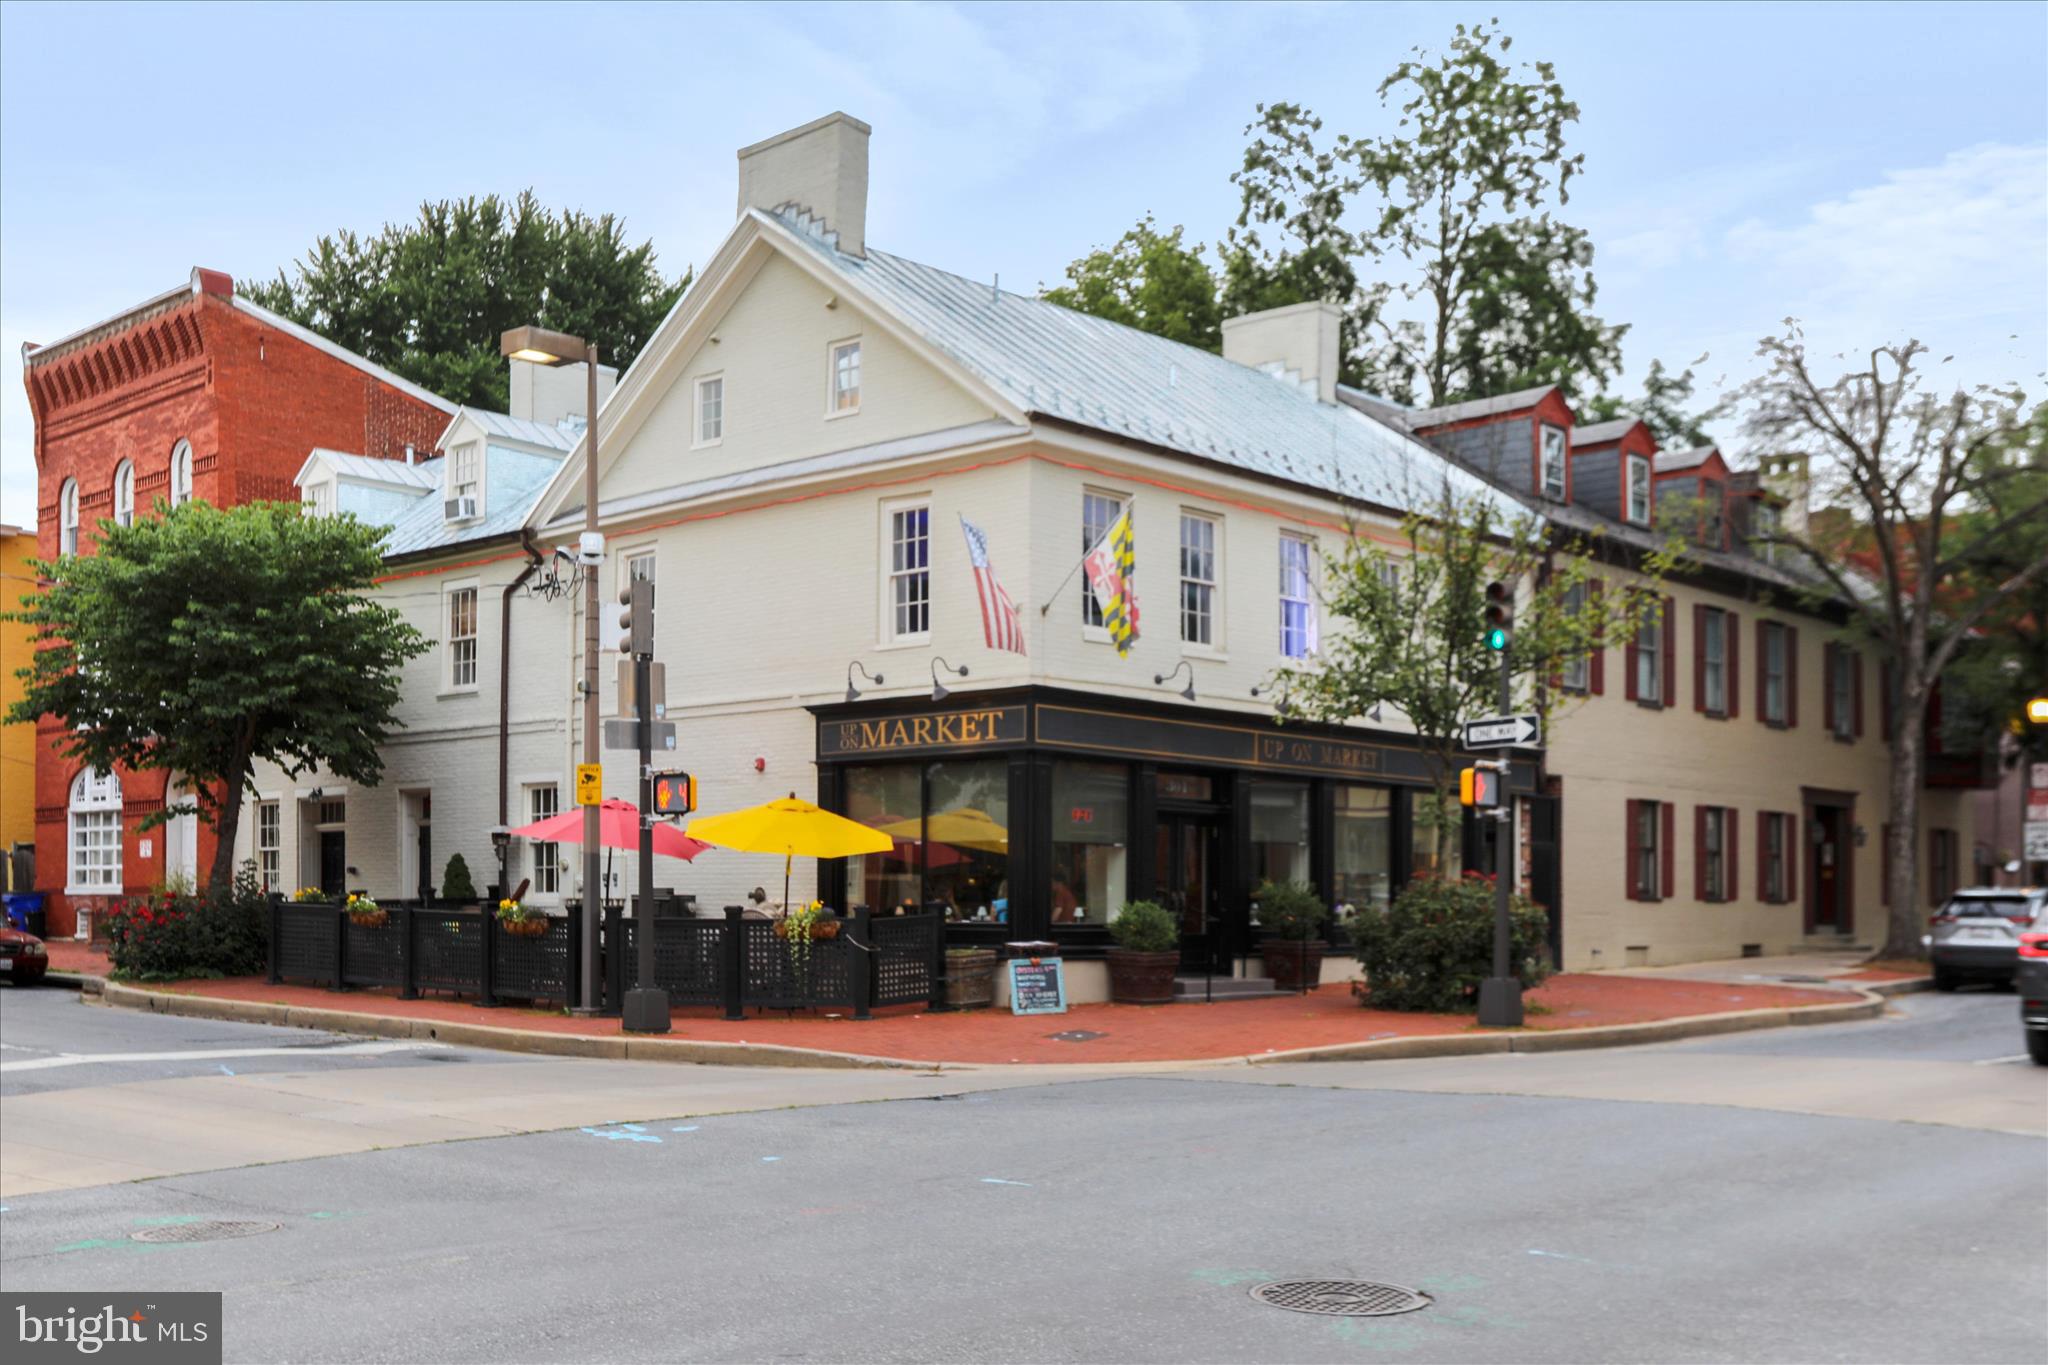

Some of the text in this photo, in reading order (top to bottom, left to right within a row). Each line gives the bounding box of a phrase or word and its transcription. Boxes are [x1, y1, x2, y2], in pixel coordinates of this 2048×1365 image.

[840, 723, 857, 736] UP
[860, 711, 1003, 749] MARKET
[1474, 727, 1491, 739] ONE
[840, 737, 858, 750] ON
[1264, 739, 1377, 769] UP ON MARKET
